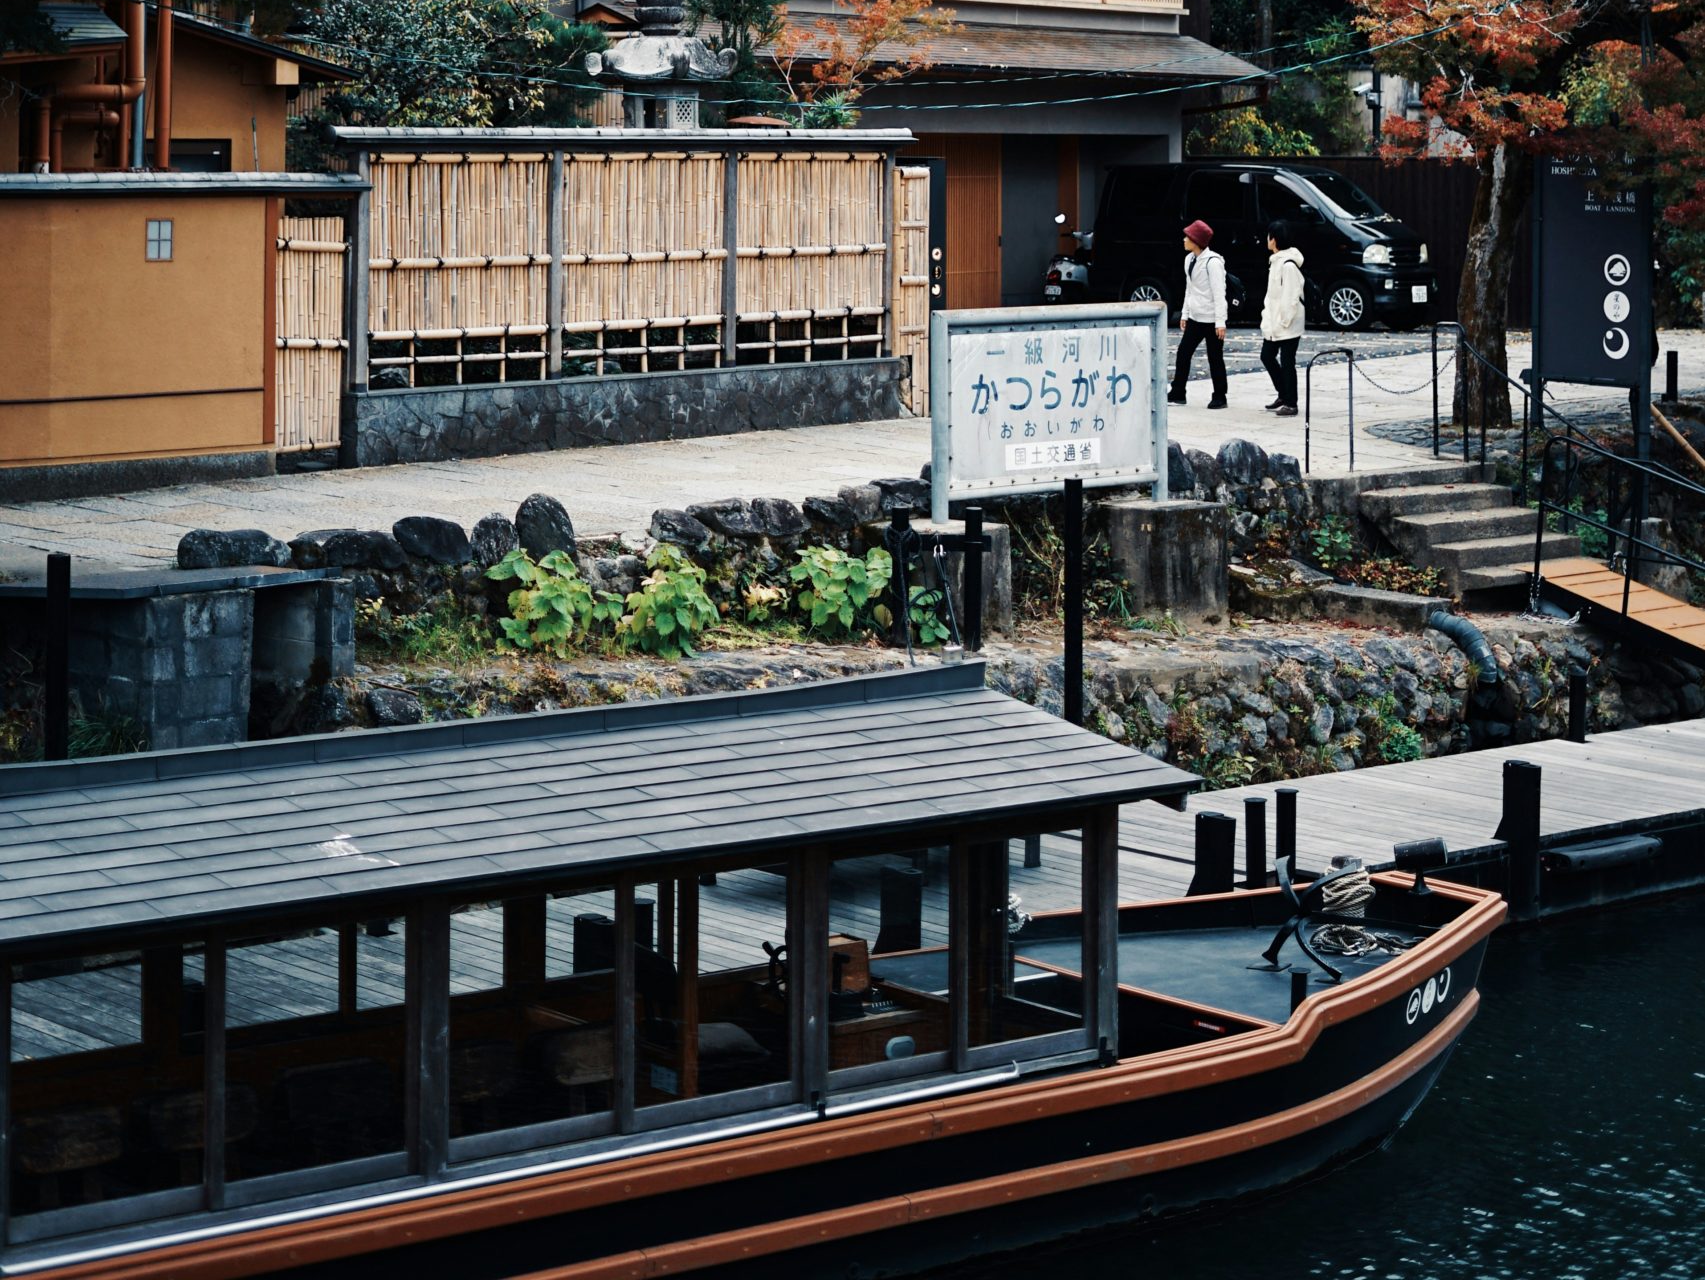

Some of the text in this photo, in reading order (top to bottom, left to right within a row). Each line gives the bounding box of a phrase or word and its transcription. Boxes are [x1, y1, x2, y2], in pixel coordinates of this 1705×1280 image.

[1584, 204, 1636, 213] BOAT LANDING
[986, 334, 1117, 366] 一級河川
[971, 366, 1132, 415] かつらがわ
[1014, 441, 1092, 465] 国土交通省
